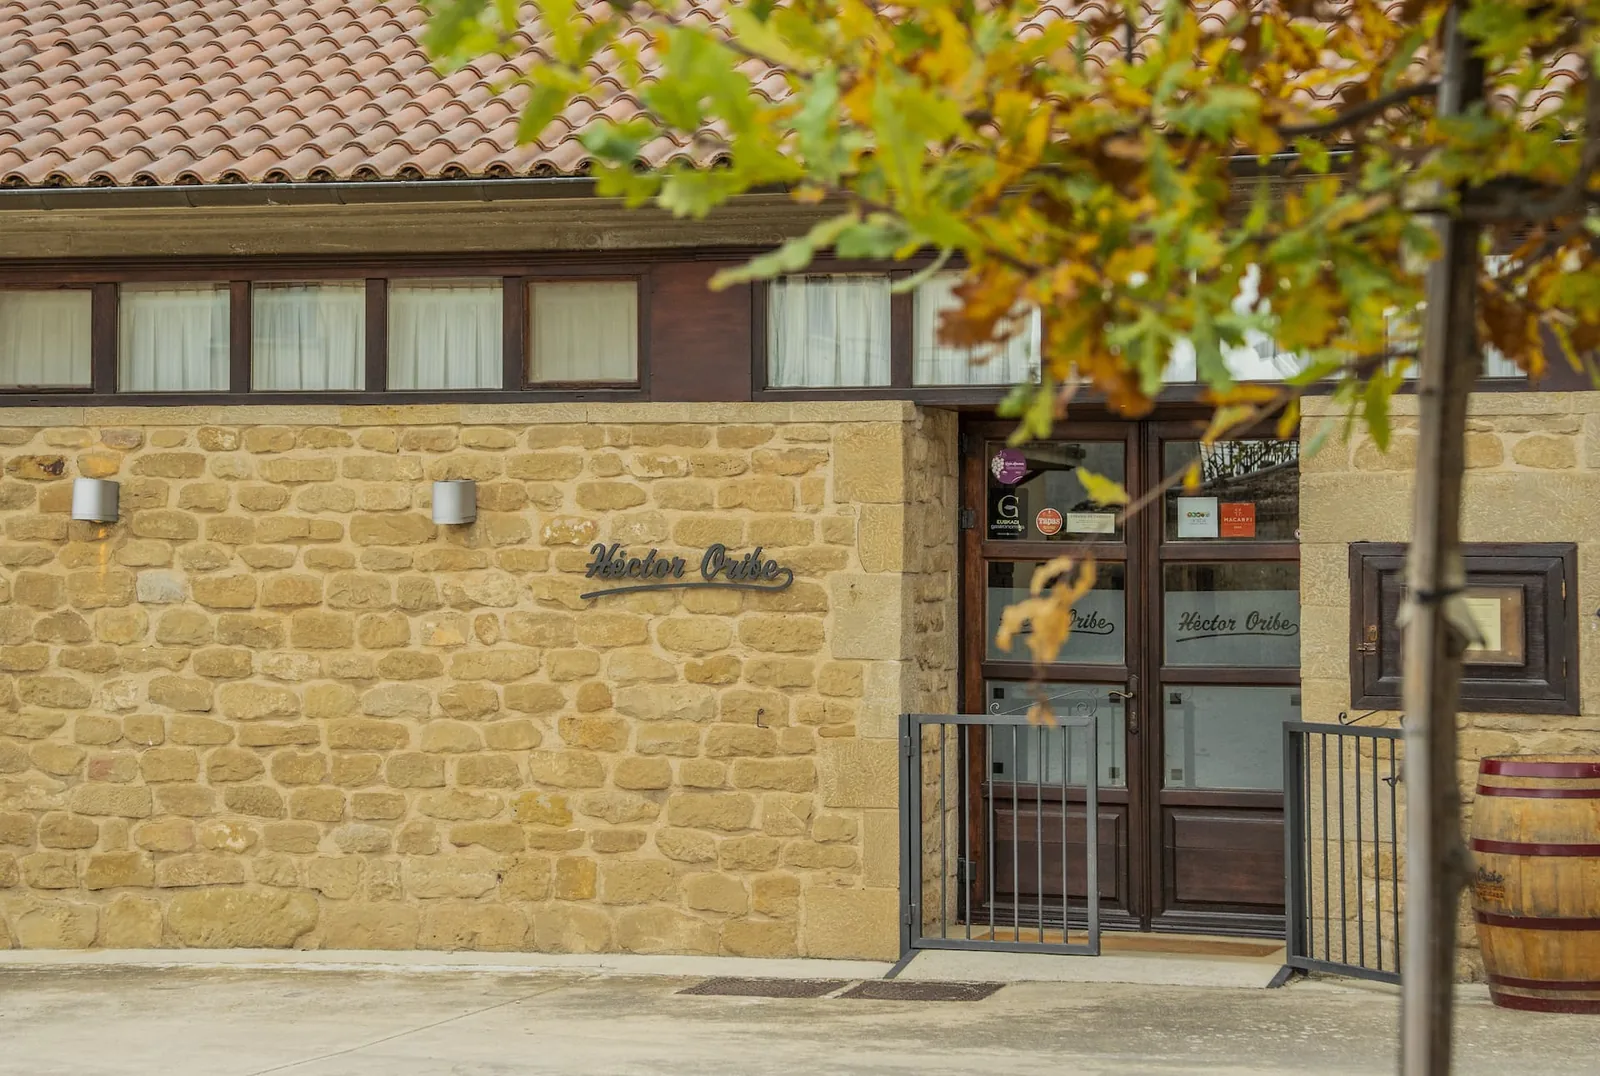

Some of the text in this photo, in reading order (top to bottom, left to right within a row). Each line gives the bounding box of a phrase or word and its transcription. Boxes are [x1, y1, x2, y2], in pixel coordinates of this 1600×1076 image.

[584, 543, 793, 585] Héctor Oribe
[1178, 610, 1298, 633] Héctor Oribe
